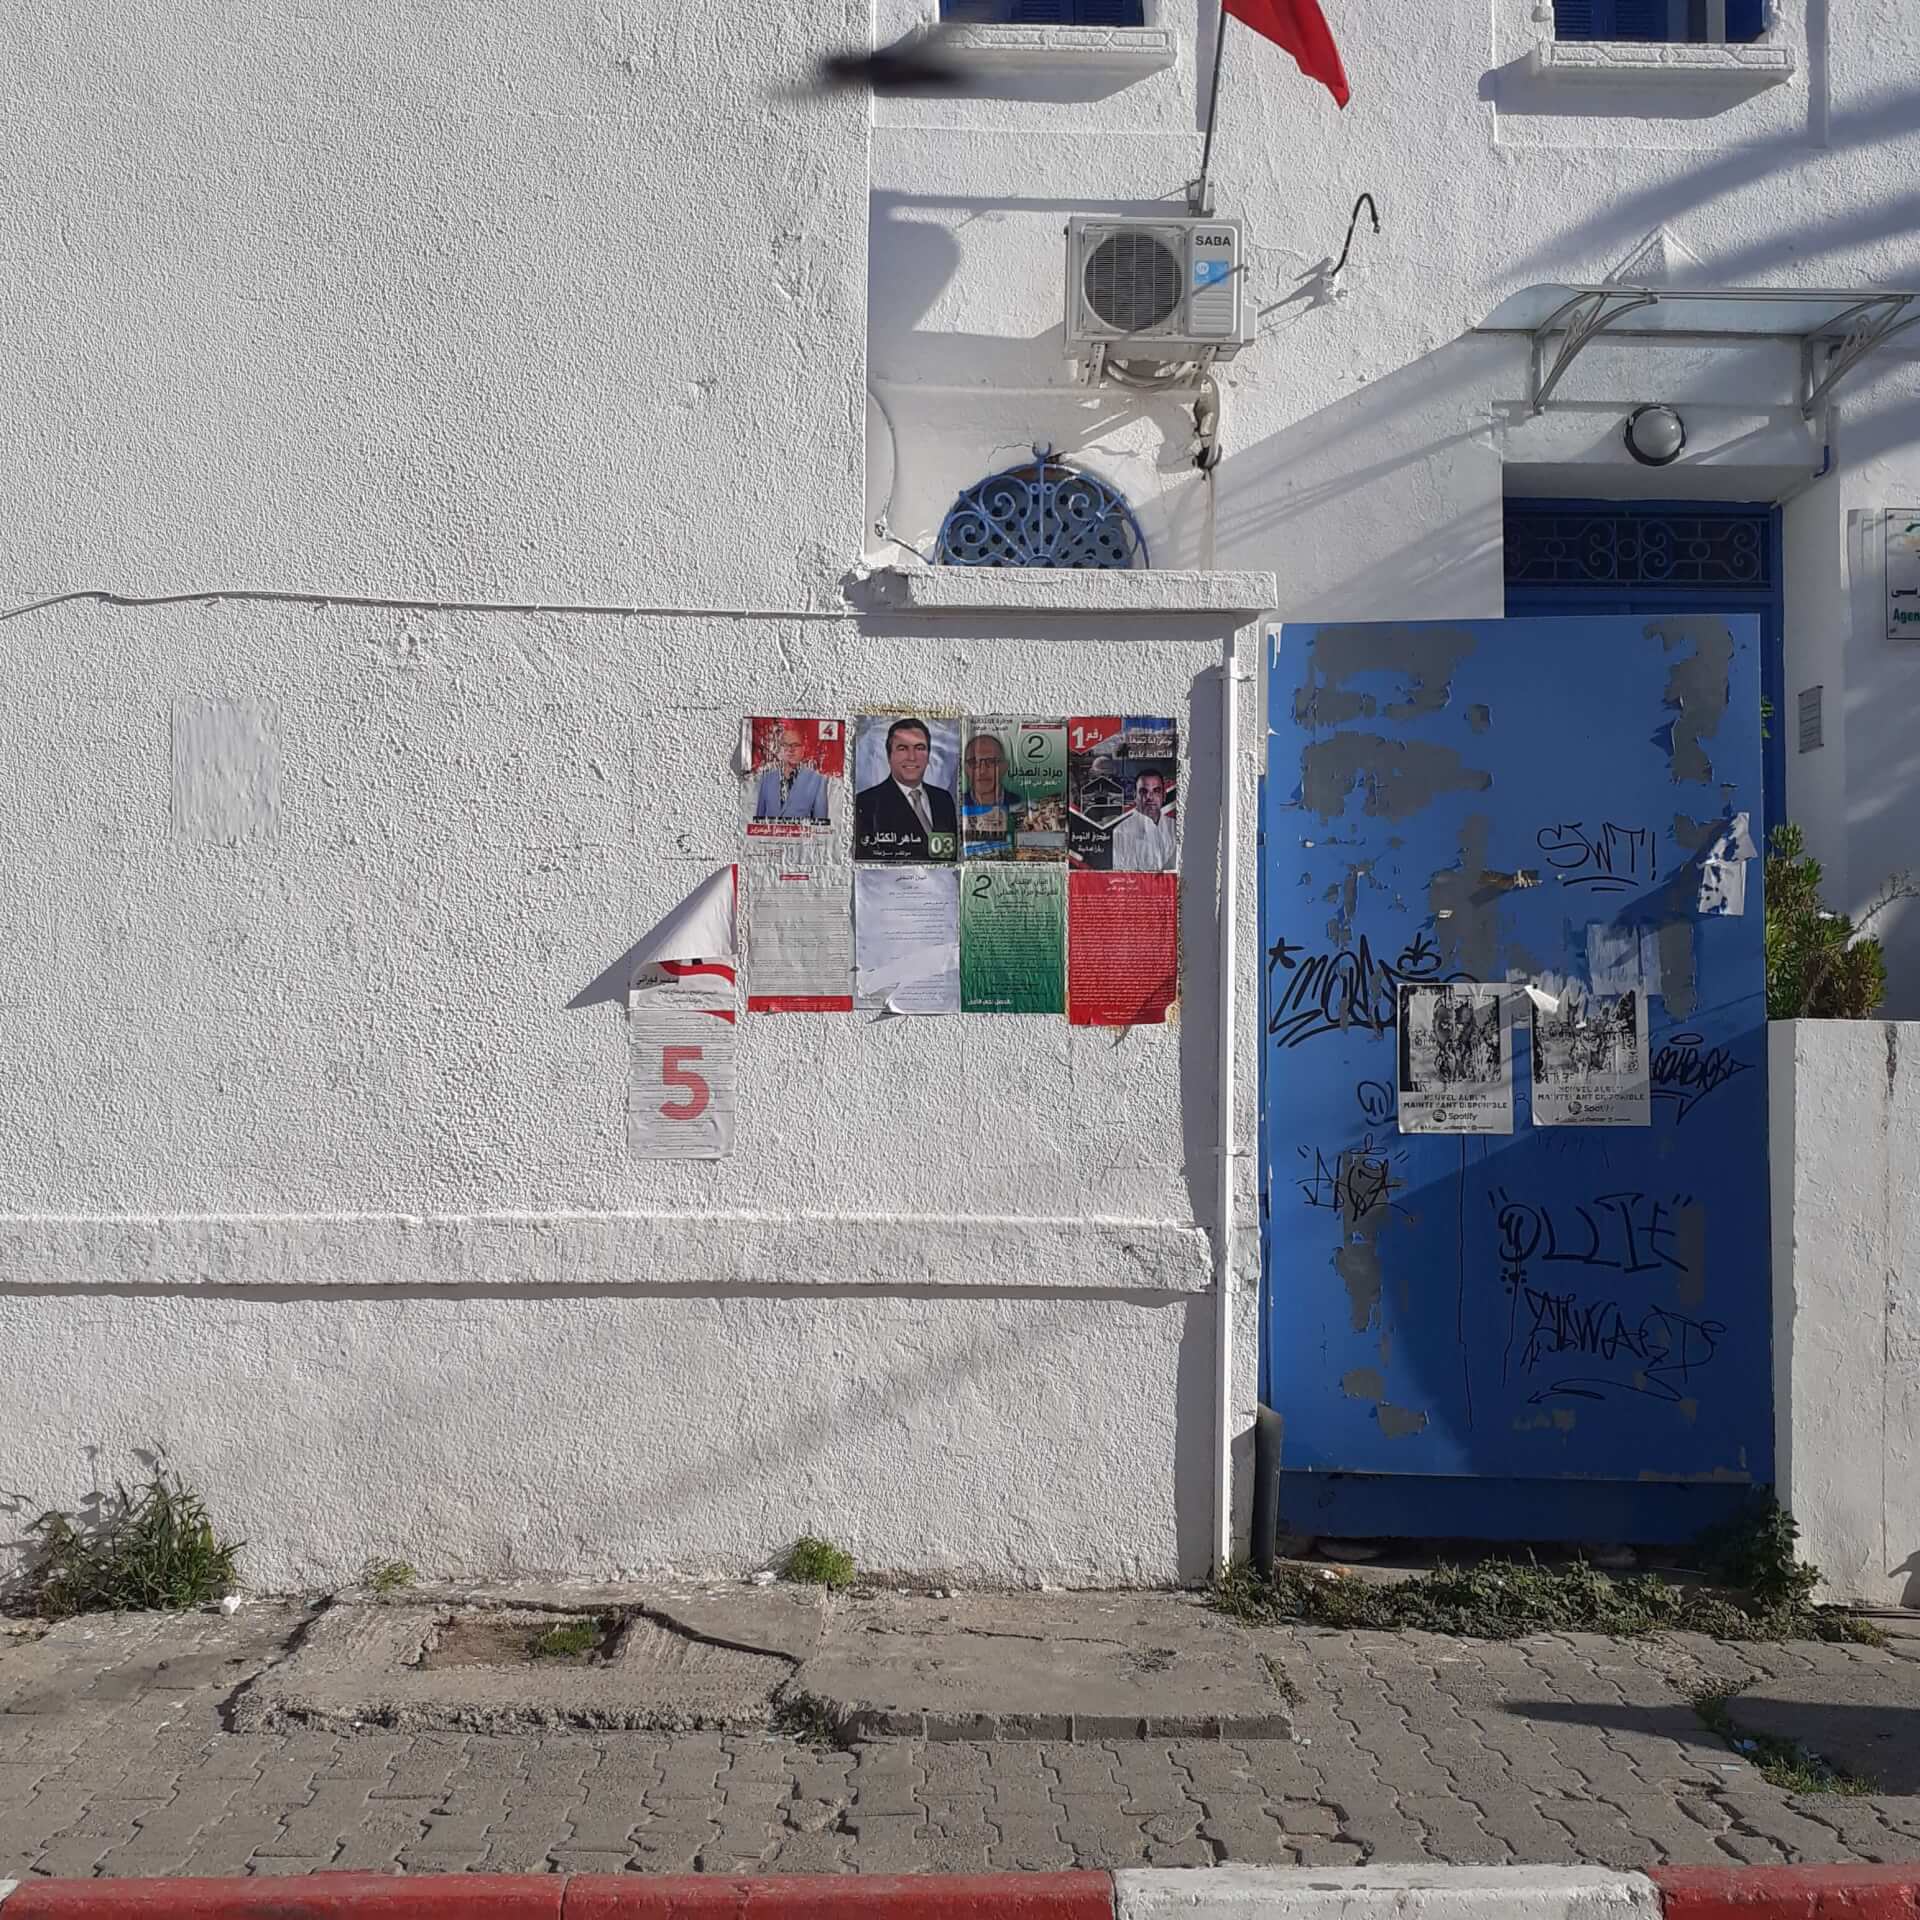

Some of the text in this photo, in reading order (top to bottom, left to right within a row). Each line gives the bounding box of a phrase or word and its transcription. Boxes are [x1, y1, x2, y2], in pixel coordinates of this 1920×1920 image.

[1195, 235, 1231, 247] SABA
[822, 725, 834, 738] 4
[1072, 726, 1102, 748] رقم 1
[1028, 735, 1044, 758] 2
[897, 832, 922, 845] ماهر
[931, 837, 954, 854] 03
[972, 875, 992, 899] 2
[659, 1045, 710, 1121] 5
[1448, 1112, 1477, 1121] Spotify
